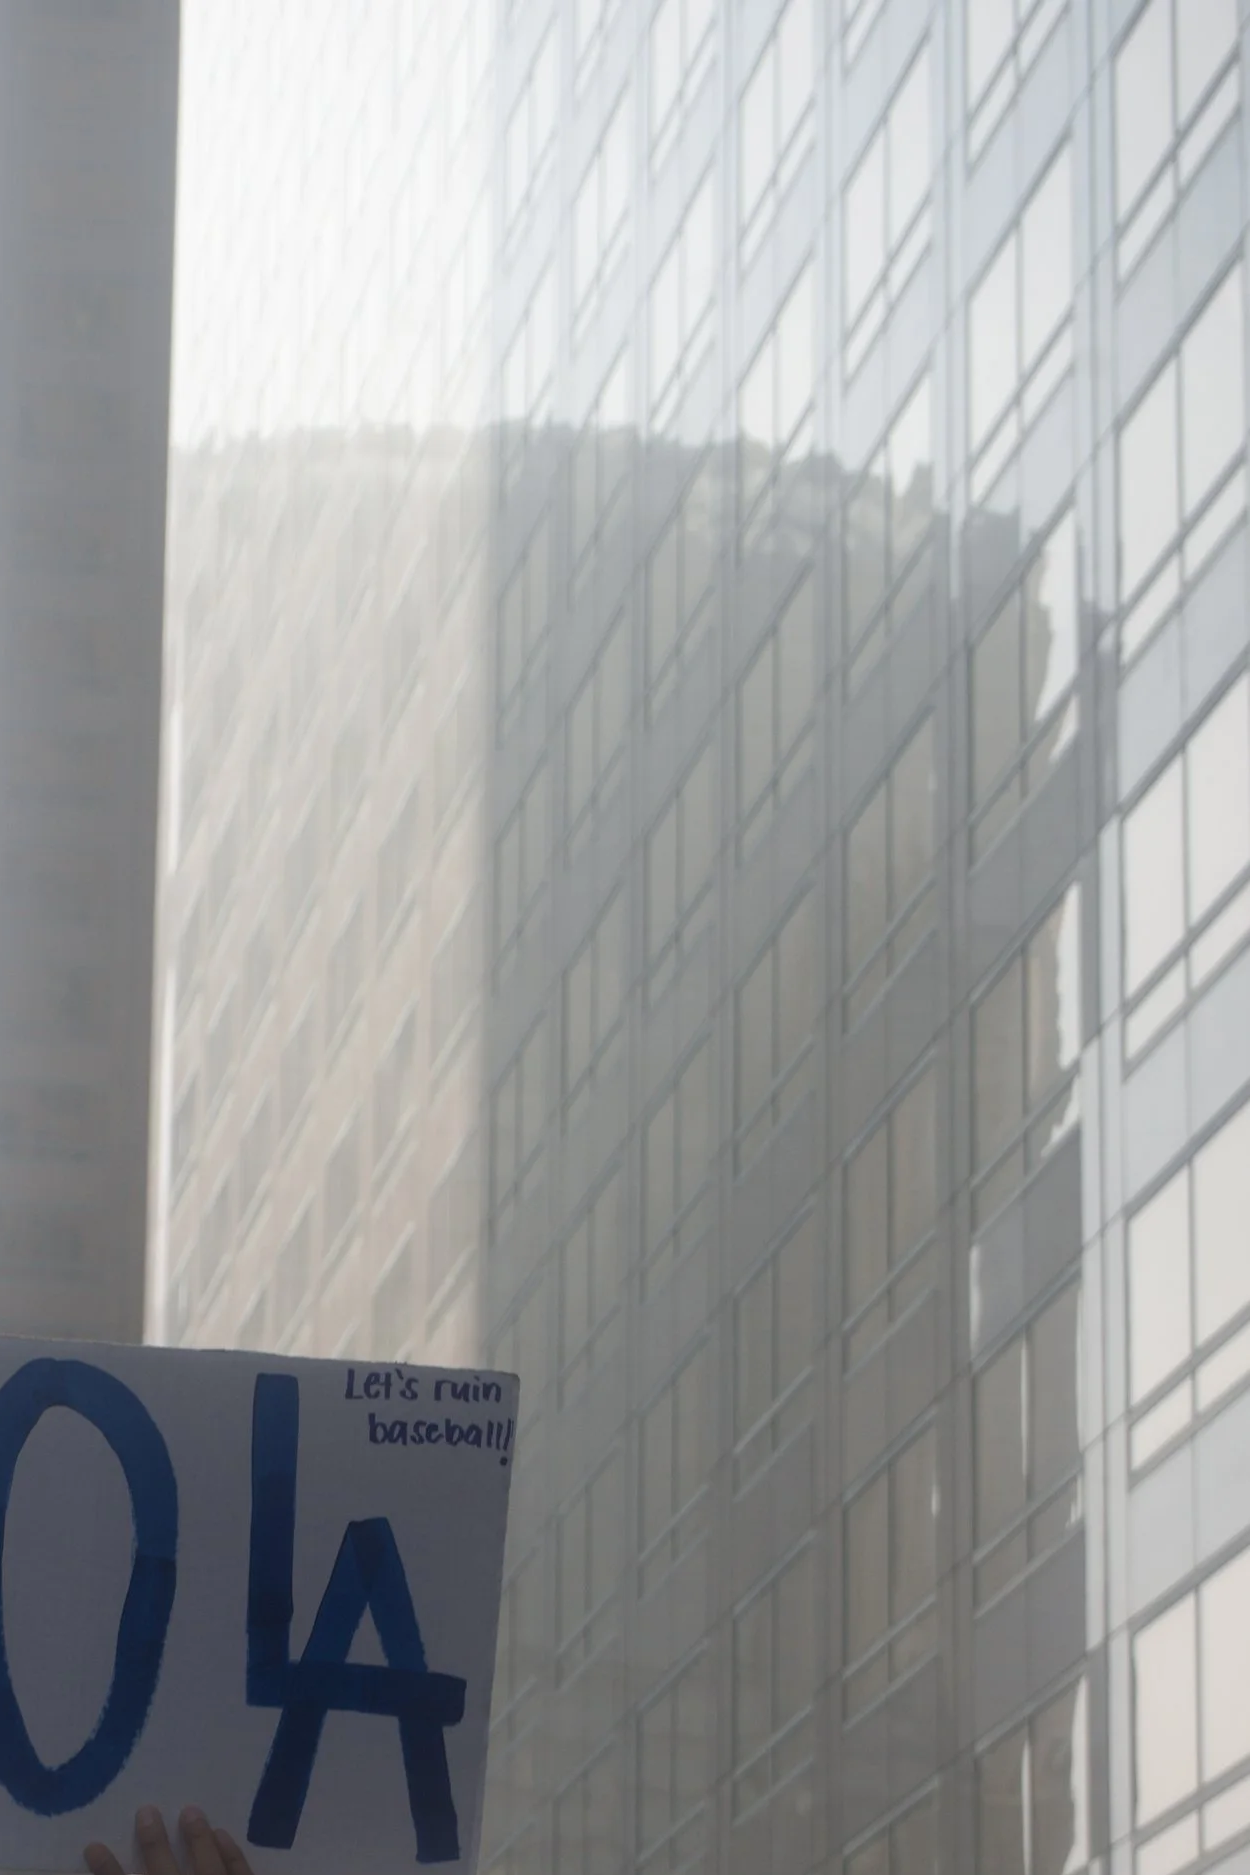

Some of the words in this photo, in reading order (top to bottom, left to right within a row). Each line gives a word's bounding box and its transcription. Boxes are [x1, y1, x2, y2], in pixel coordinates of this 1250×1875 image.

[344, 1368, 419, 1401] Let's
[434, 1375, 502, 1403] ruin
[246, 1373, 467, 1863] LA
